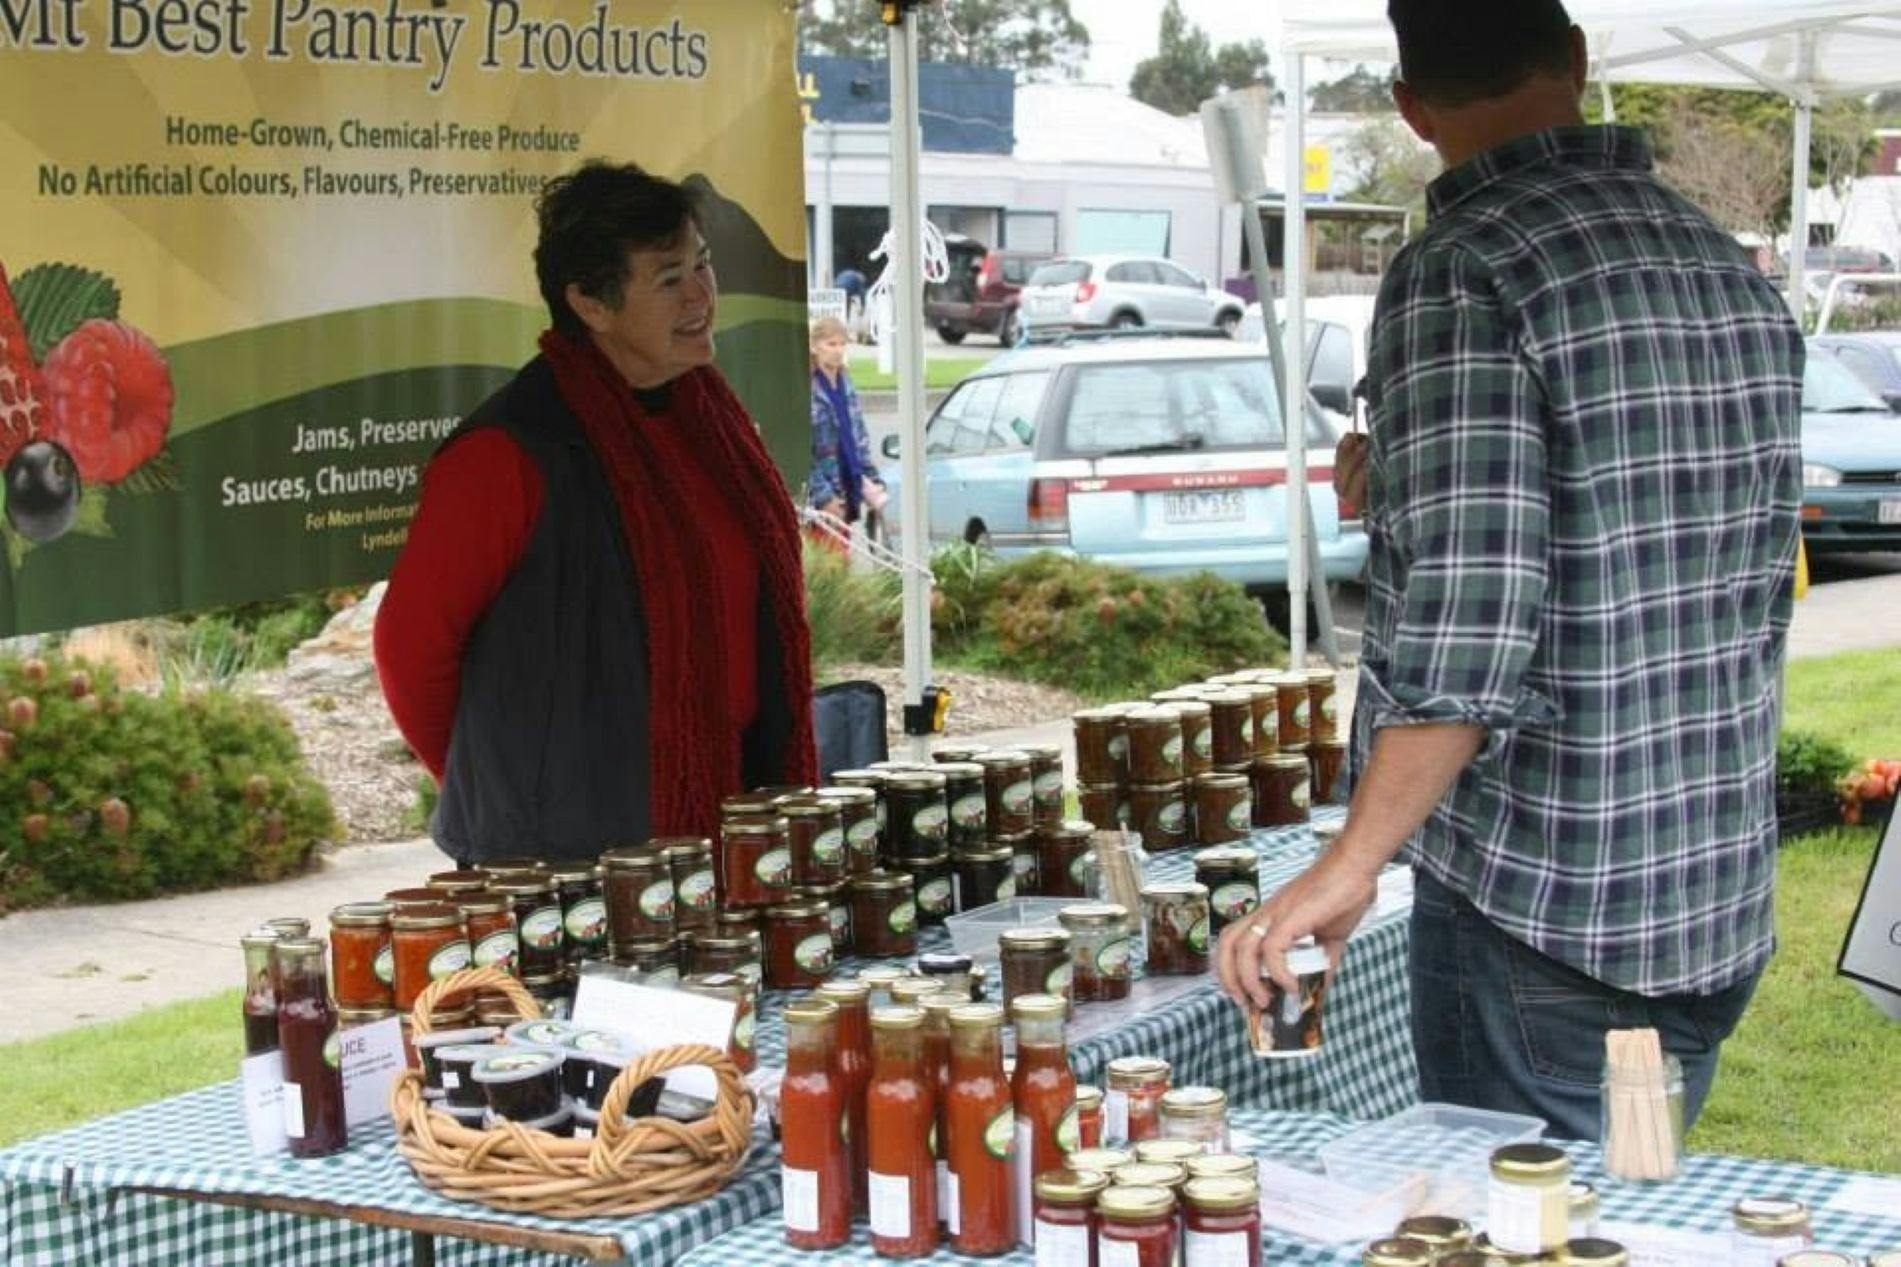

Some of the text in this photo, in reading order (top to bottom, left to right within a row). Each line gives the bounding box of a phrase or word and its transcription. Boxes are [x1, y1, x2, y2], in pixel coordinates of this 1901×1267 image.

[0, 0, 708, 92] Mt Best Pantry Products
[166, 117, 580, 151] Home-Grown, Chemical-Free Produce
[38, 165, 76, 195] No
[84, 163, 193, 195] Artificial
[200, 166, 298, 198] Colours,
[303, 165, 404, 198] Flavours,
[292, 424, 355, 453] Jams,
[222, 463, 418, 507] Sauces, Chutneys
[305, 513, 325, 531] For
[327, 509, 362, 528] More
